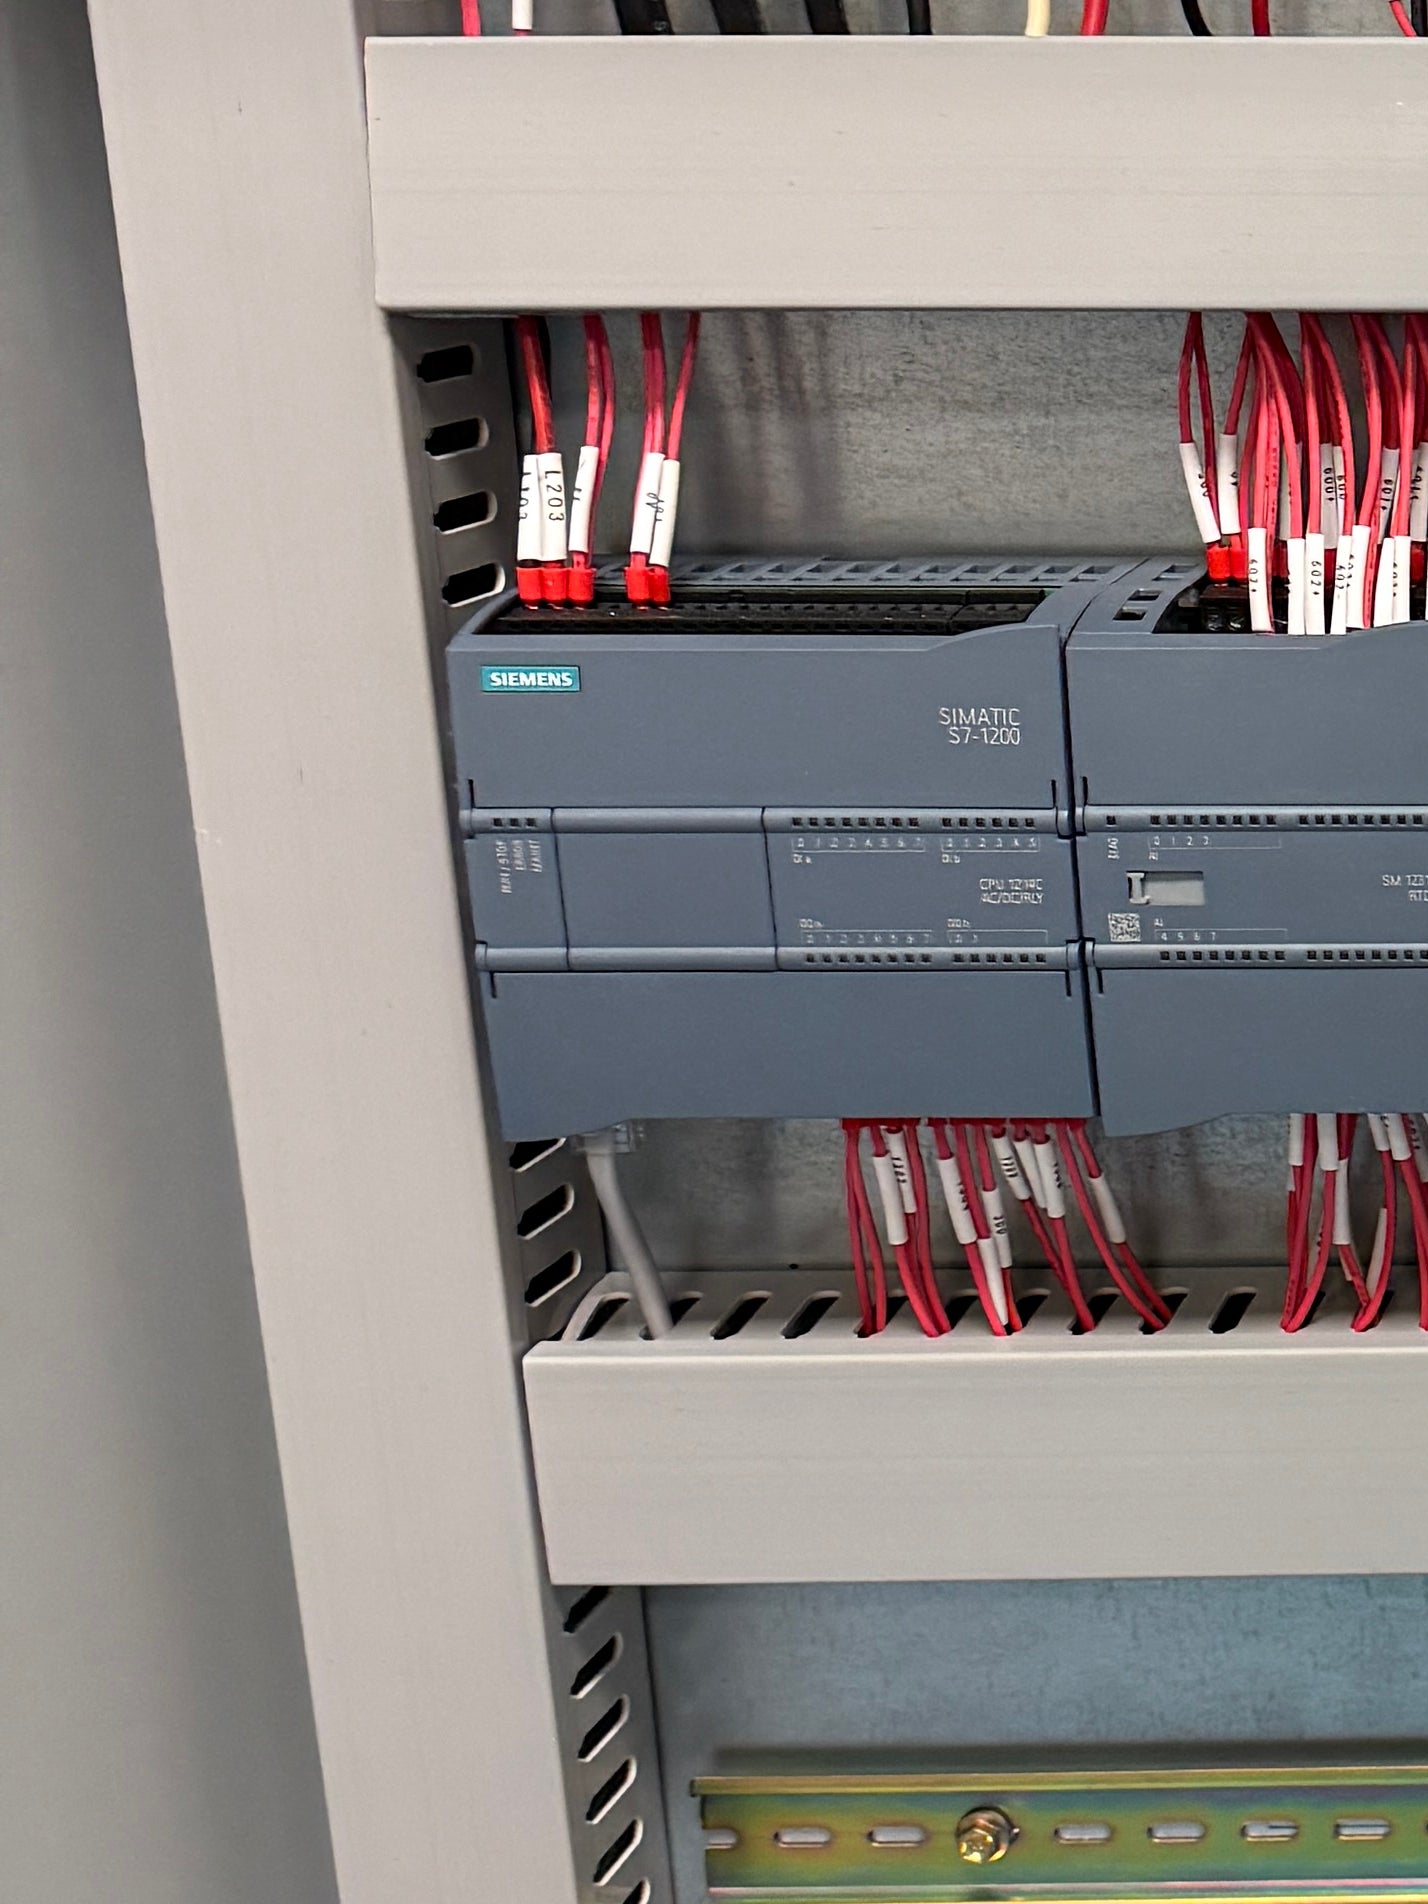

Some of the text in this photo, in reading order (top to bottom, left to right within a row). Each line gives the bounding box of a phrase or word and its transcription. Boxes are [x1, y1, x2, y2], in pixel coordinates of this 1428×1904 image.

[544, 470, 565, 522] L203
[489, 670, 573, 688] SIEMENS
[938, 706, 1021, 727] SIMATIC
[948, 727, 1021, 746] S7-1200
[979, 878, 1004, 891] CPU
[1381, 874, 1402, 888] SM
